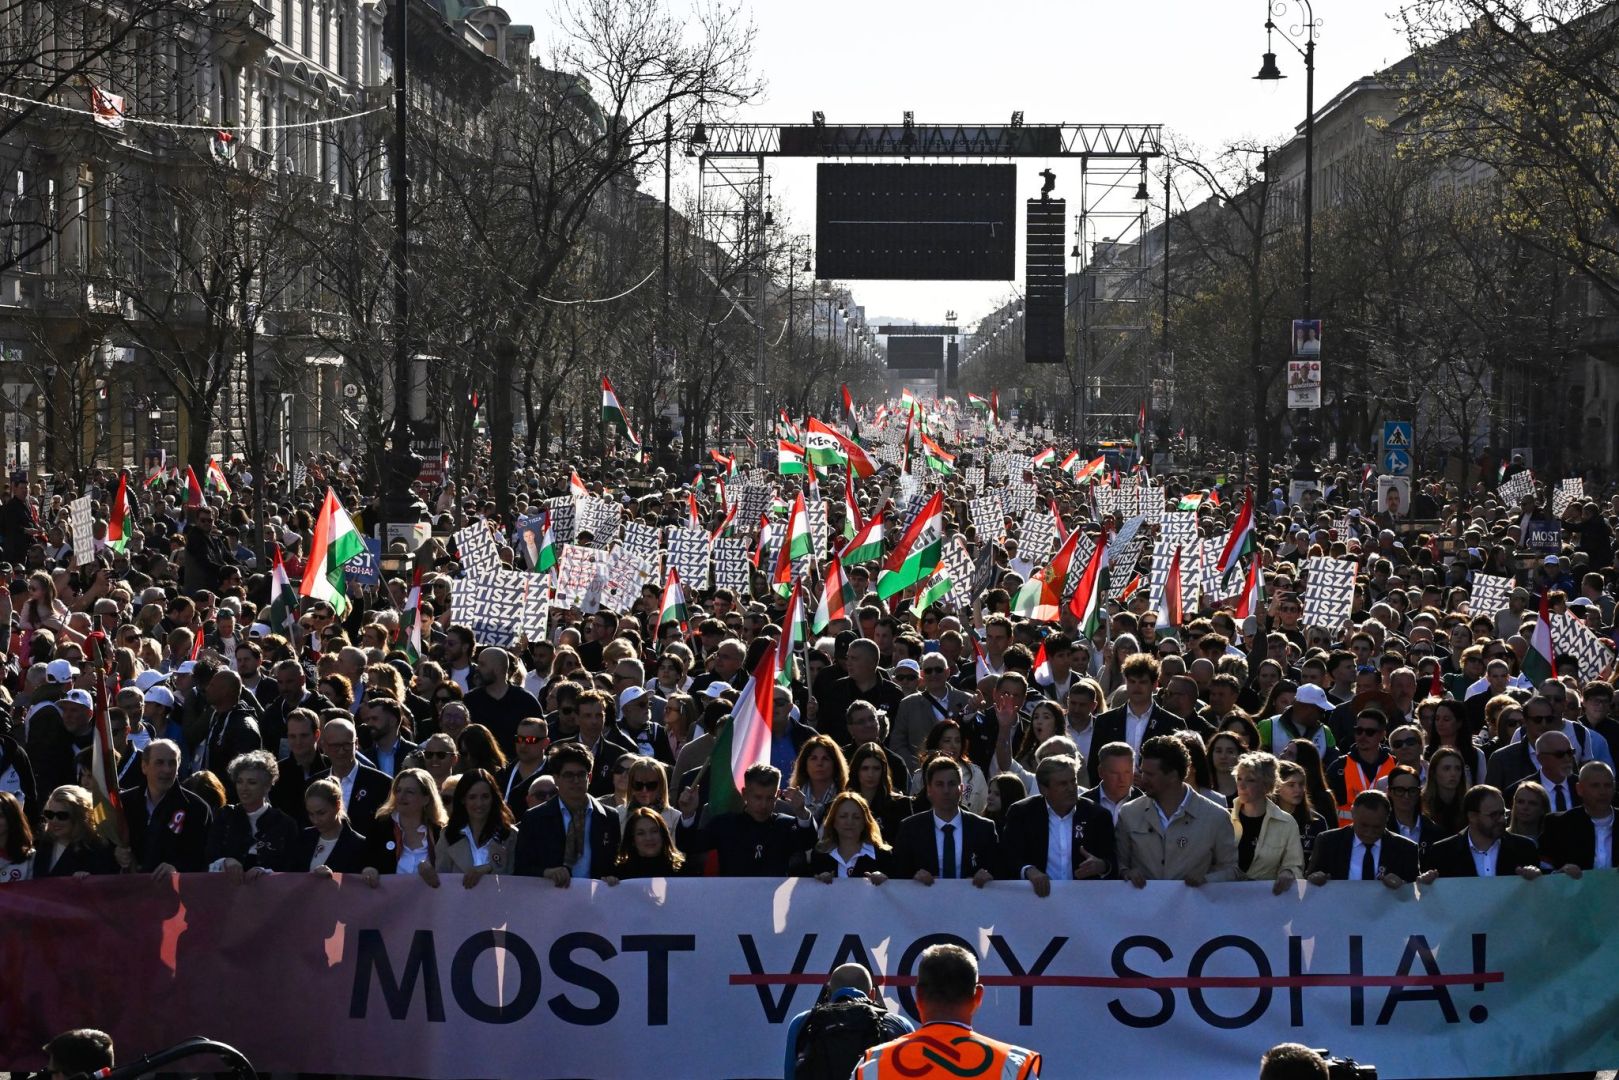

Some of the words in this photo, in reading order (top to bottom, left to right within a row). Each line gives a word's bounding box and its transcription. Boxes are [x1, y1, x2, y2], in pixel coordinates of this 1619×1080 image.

[1011, 460, 1034, 468] TISZA
[1511, 470, 1530, 480] TISZA
[550, 495, 576, 508] TISZA
[969, 495, 999, 508] TISZA
[550, 507, 576, 520] TISZA
[970, 504, 1002, 516] TISZA
[972, 512, 1004, 525] TISZA
[1024, 510, 1056, 524] TISZA
[1160, 512, 1197, 522] TISZA
[453, 519, 489, 545] TISZA
[626, 521, 660, 536] TISZA
[975, 521, 1005, 534] TISZA
[1022, 520, 1056, 533] TISZA
[1160, 522, 1196, 532] TISZA
[624, 532, 660, 548] TISZA
[668, 528, 710, 541] TISZA
[1020, 530, 1054, 543] TISZA
[1532, 531, 1558, 542] MOST
[457, 531, 493, 557] TISZA
[668, 540, 710, 553] TISZA
[714, 538, 748, 549] TISZA
[1018, 540, 1052, 552] TISZA
[1154, 542, 1200, 556] TISZA
[460, 543, 498, 568] TISZA
[666, 552, 710, 566] TISZA
[714, 549, 748, 560] TISZA
[715, 560, 748, 572] TISZA
[1152, 556, 1200, 571] TIZA
[1310, 556, 1354, 574] TISZA
[345, 565, 374, 576] SOHA!
[478, 570, 526, 590] TISZA
[716, 572, 749, 583] TISZA
[1151, 570, 1200, 586] TIZA
[1309, 570, 1354, 588] TISZA
[1474, 572, 1516, 589] TISZA
[452, 579, 476, 592] TIS
[1472, 584, 1506, 600] TISZ
[452, 593, 476, 606] TIS
[476, 586, 525, 604] TISZA
[1307, 584, 1353, 602] TISZA
[451, 607, 474, 620] TIS
[474, 600, 524, 619] TISZA
[1305, 598, 1352, 616] TISZA
[472, 615, 522, 634] TISZA
[473, 630, 520, 648] TISZA
[349, 929, 695, 1025] MOST
[1107, 933, 1489, 1029] SOHA!
